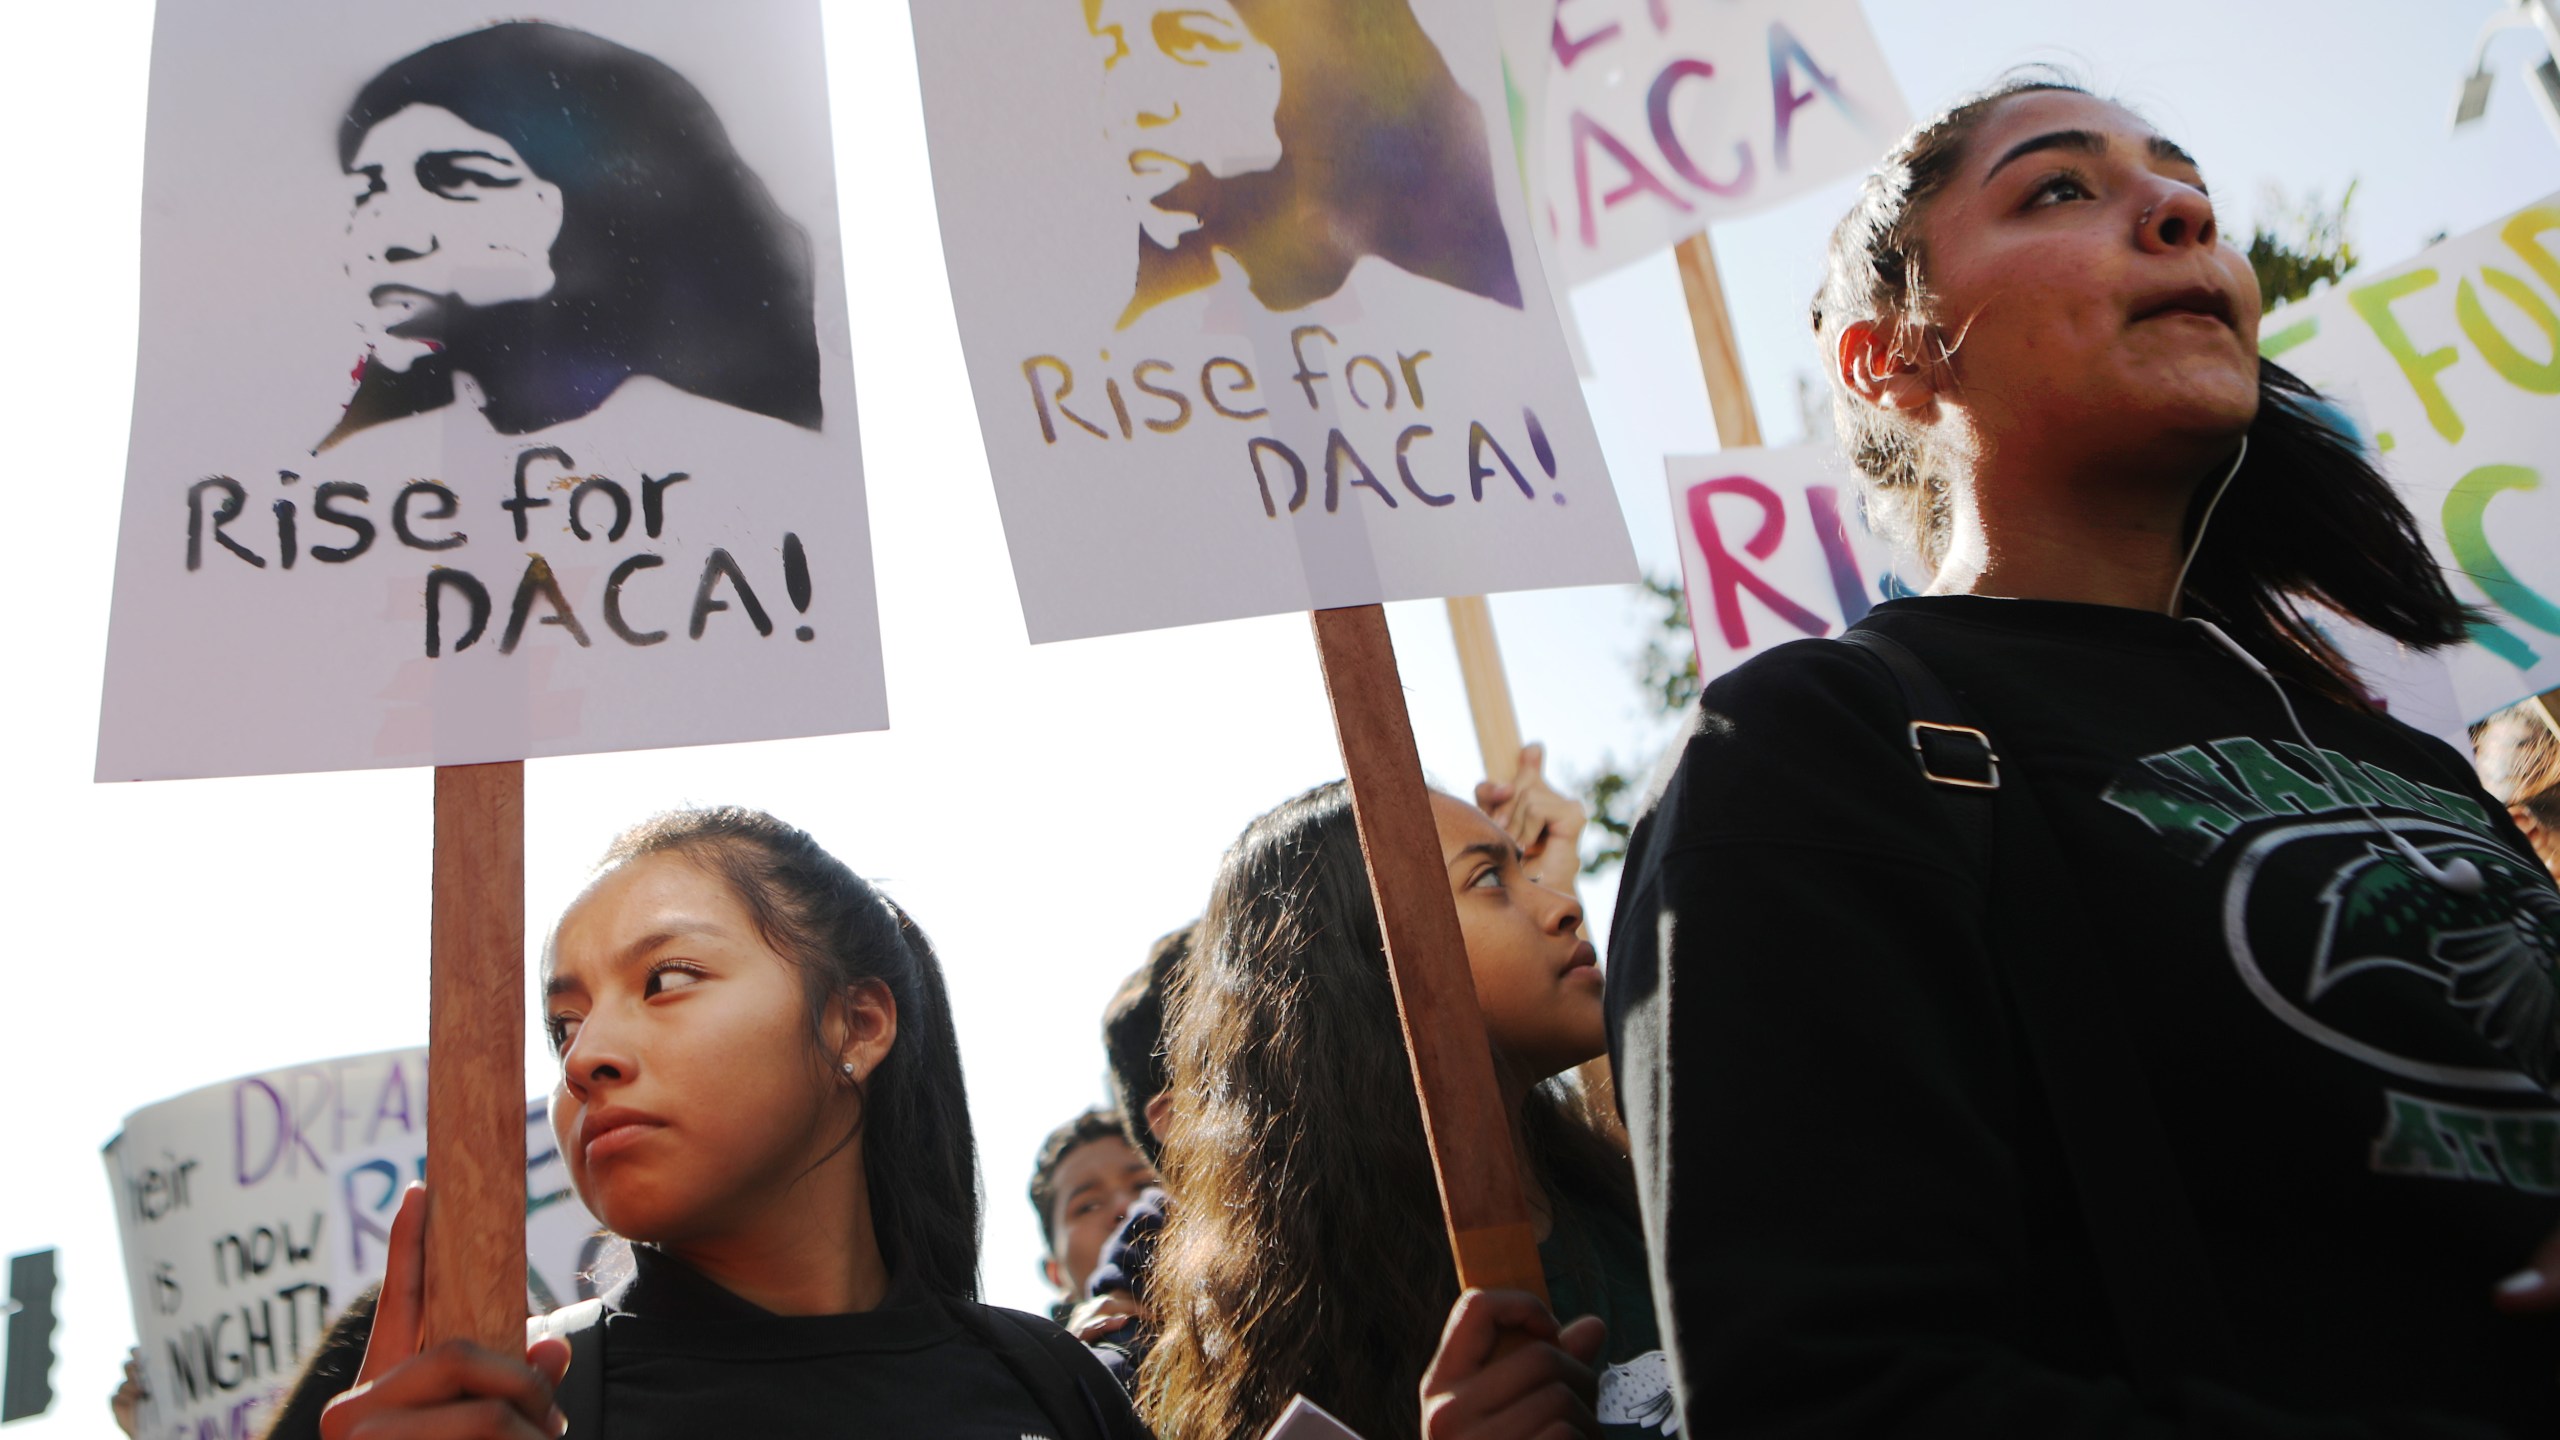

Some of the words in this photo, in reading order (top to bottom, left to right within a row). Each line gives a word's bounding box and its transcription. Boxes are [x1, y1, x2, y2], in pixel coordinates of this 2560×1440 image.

[1548, 20, 1890, 248] ACA
[1022, 348, 1268, 444] Rise
[1291, 324, 1432, 411] for
[186, 469, 469, 572] Rise
[501, 445, 690, 543] for
[1247, 406, 1567, 518] DACA!
[424, 532, 815, 658] DACA!
[1686, 474, 1920, 650] RI
[212, 1210, 324, 1286] now
[165, 1281, 330, 1408] NIGHT
